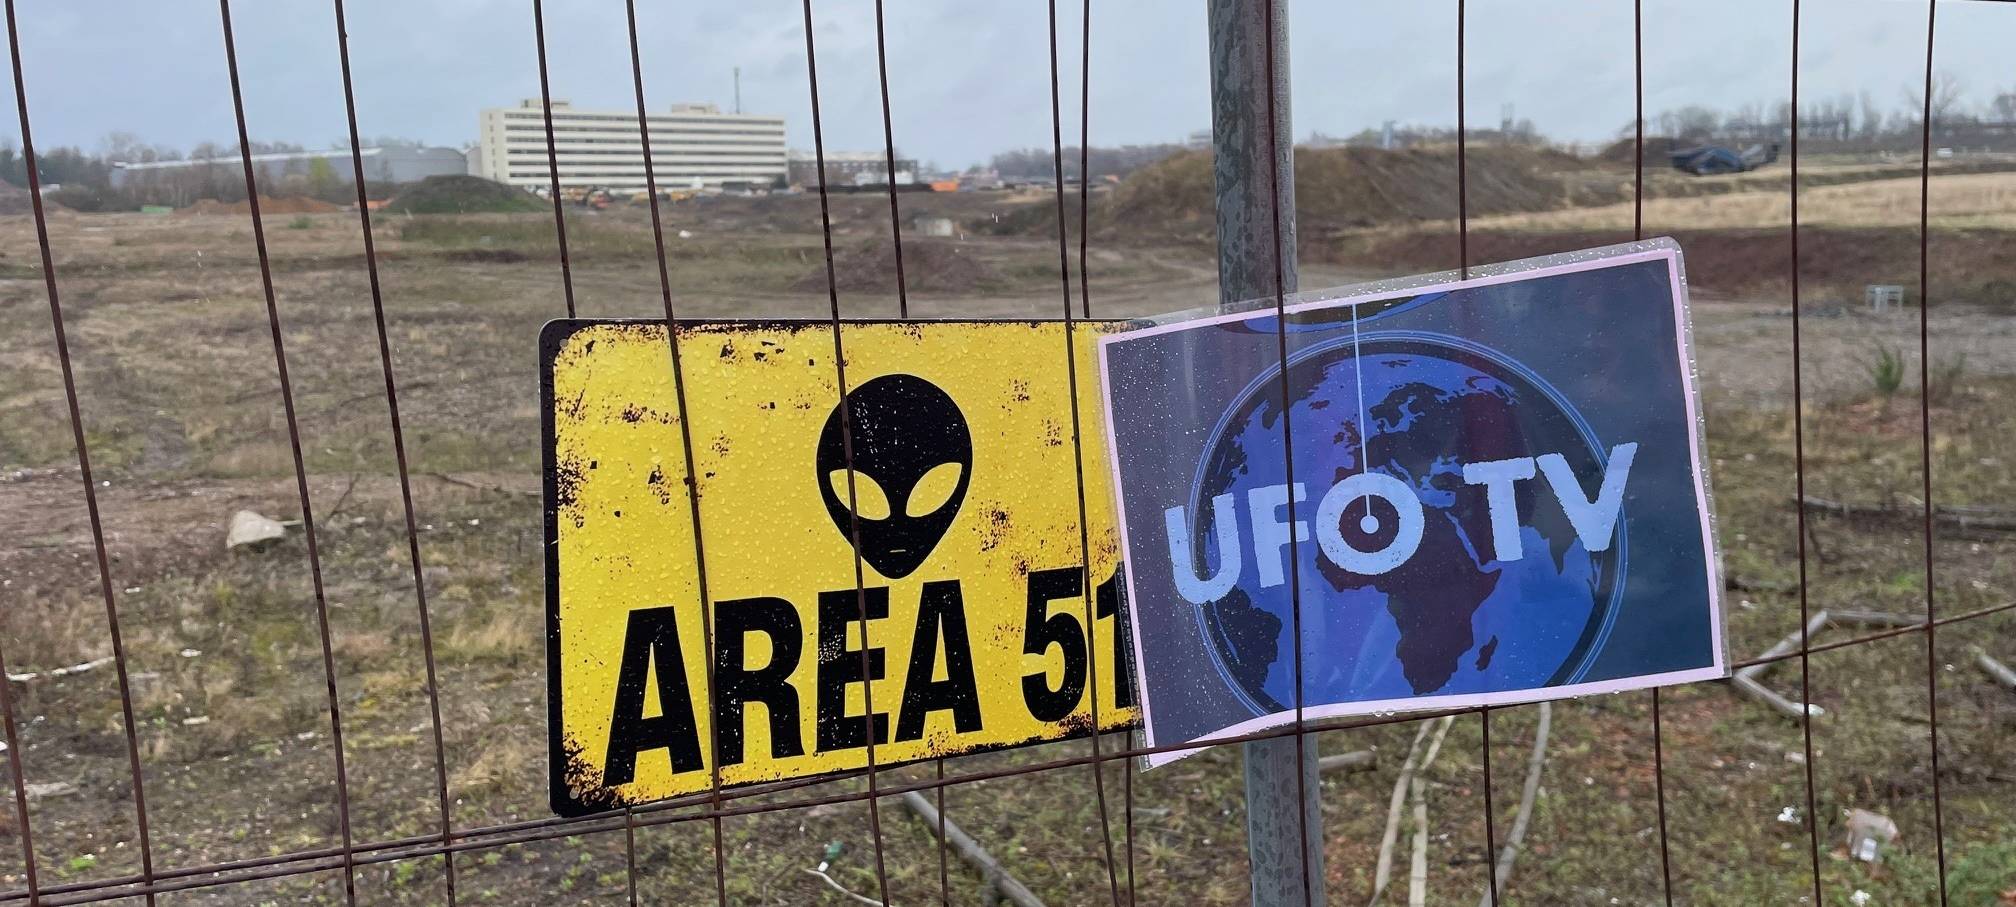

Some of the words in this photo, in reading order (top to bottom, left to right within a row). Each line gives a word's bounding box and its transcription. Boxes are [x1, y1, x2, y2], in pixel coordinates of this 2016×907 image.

[1165, 472, 1425, 604] UFO
[1463, 442, 1638, 562] TV
[602, 579, 983, 788] AREA
[1021, 562, 1140, 723] 51
